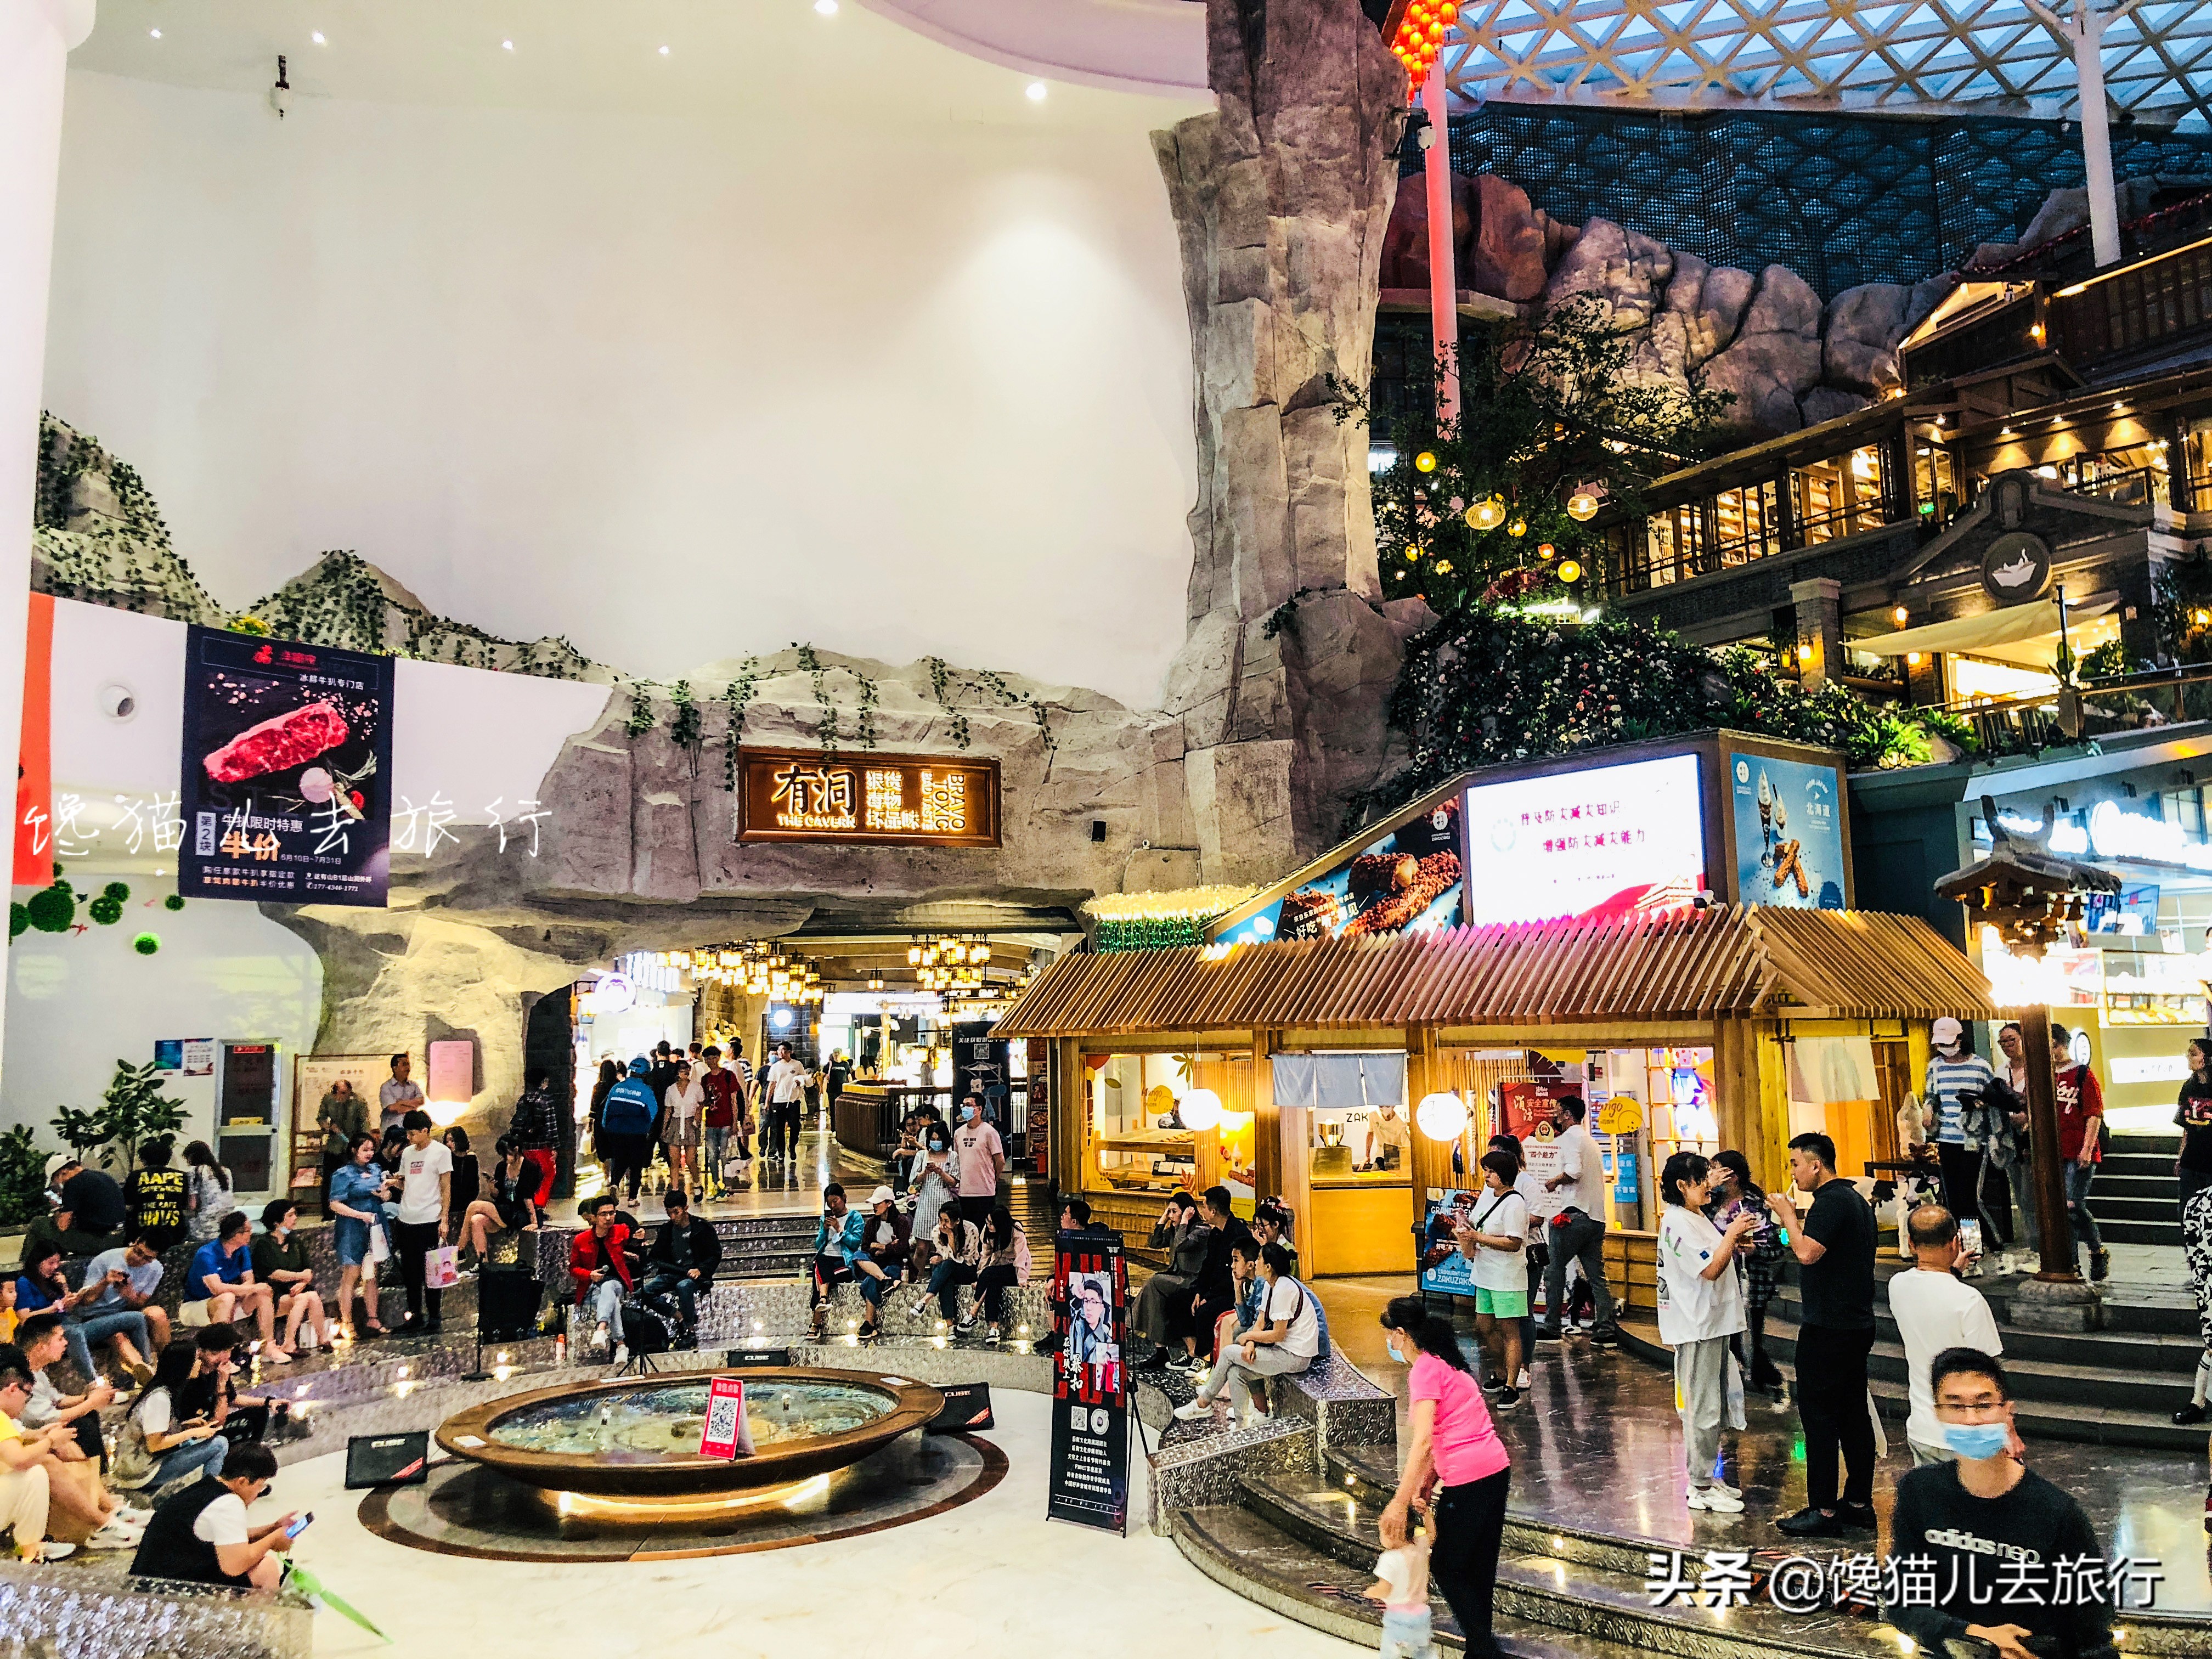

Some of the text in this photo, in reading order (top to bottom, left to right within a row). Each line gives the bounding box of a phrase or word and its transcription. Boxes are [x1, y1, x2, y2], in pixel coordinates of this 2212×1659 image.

[771, 765, 857, 816] 有洞
[922, 771, 934, 830] BAD TASTE
[934, 781, 950, 830] TOXIC
[950, 774, 966, 830] BRAVO
[777, 815, 856, 829] THE CAVERN
[221, 831, 281, 861] 半价
[138, 1171, 183, 1186] AAPE
[1925, 1528, 2040, 1564] adidas neo
